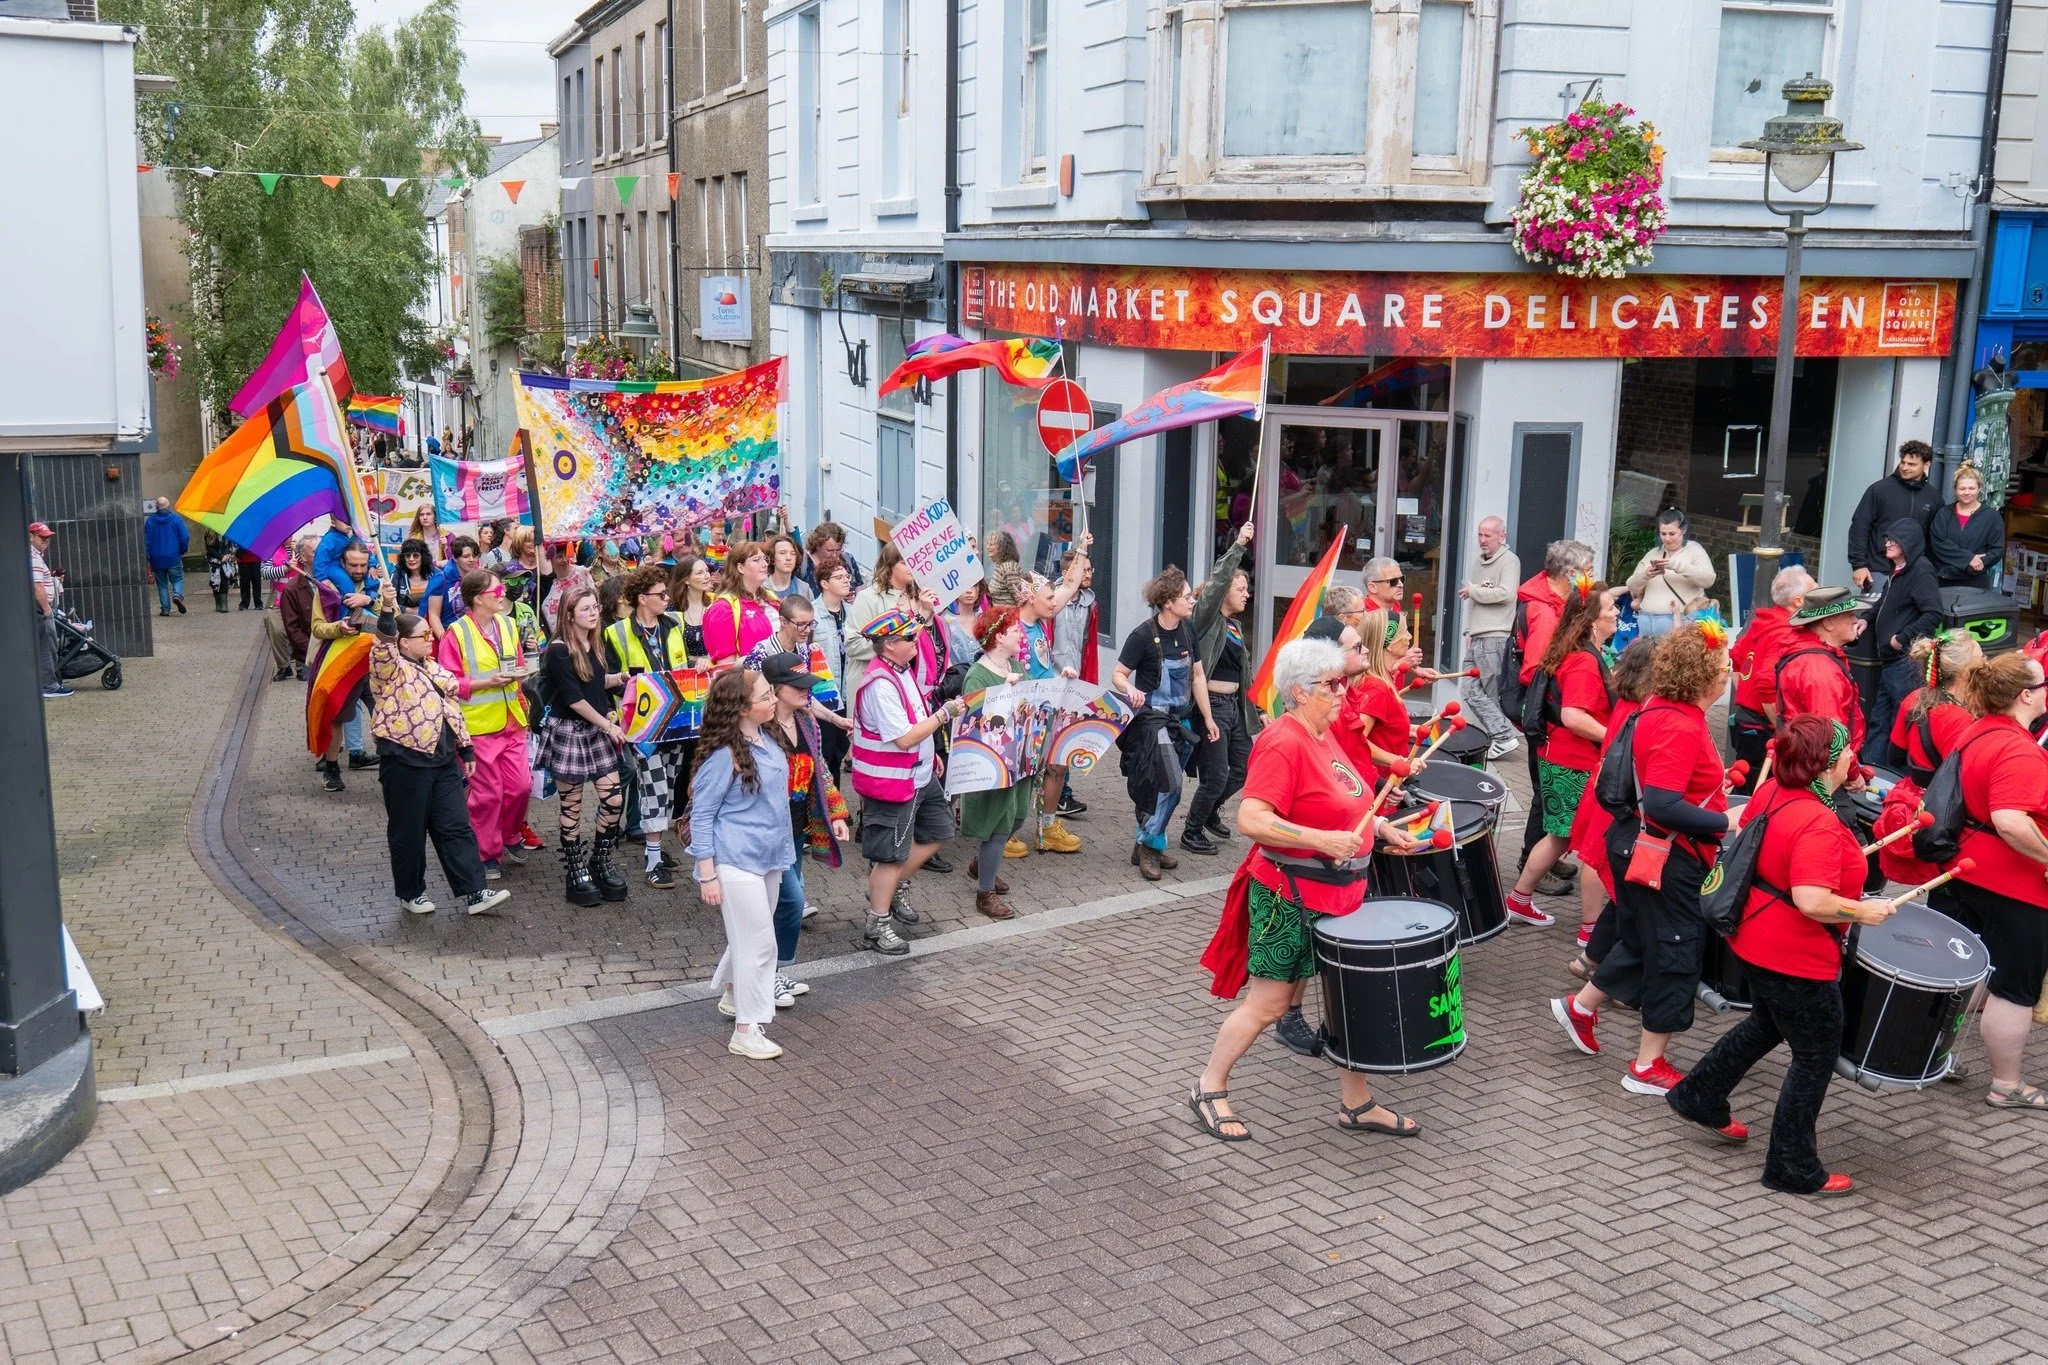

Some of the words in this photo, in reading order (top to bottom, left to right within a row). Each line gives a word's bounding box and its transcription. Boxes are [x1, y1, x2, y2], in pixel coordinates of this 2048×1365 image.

[1900, 298, 1921, 306] OLD
[2033, 287, 2043, 302] 5
[717, 306, 735, 314] Tonic
[990, 280, 1016, 309] THE
[1025, 281, 1058, 313] OLD
[1070, 285, 1189, 322] MARKET
[1220, 289, 1443, 328] SQUARE
[1483, 295, 1865, 330] DELICATESEN
[1887, 309, 1931, 318] MARKET
[1886, 320, 1930, 330] SQUARE
[906, 525, 956, 569] DESERVE
[917, 560, 933, 577] TO
[935, 531, 966, 563] GROW
[942, 569, 959, 591] UP
[1067, 686, 1091, 701] Group
